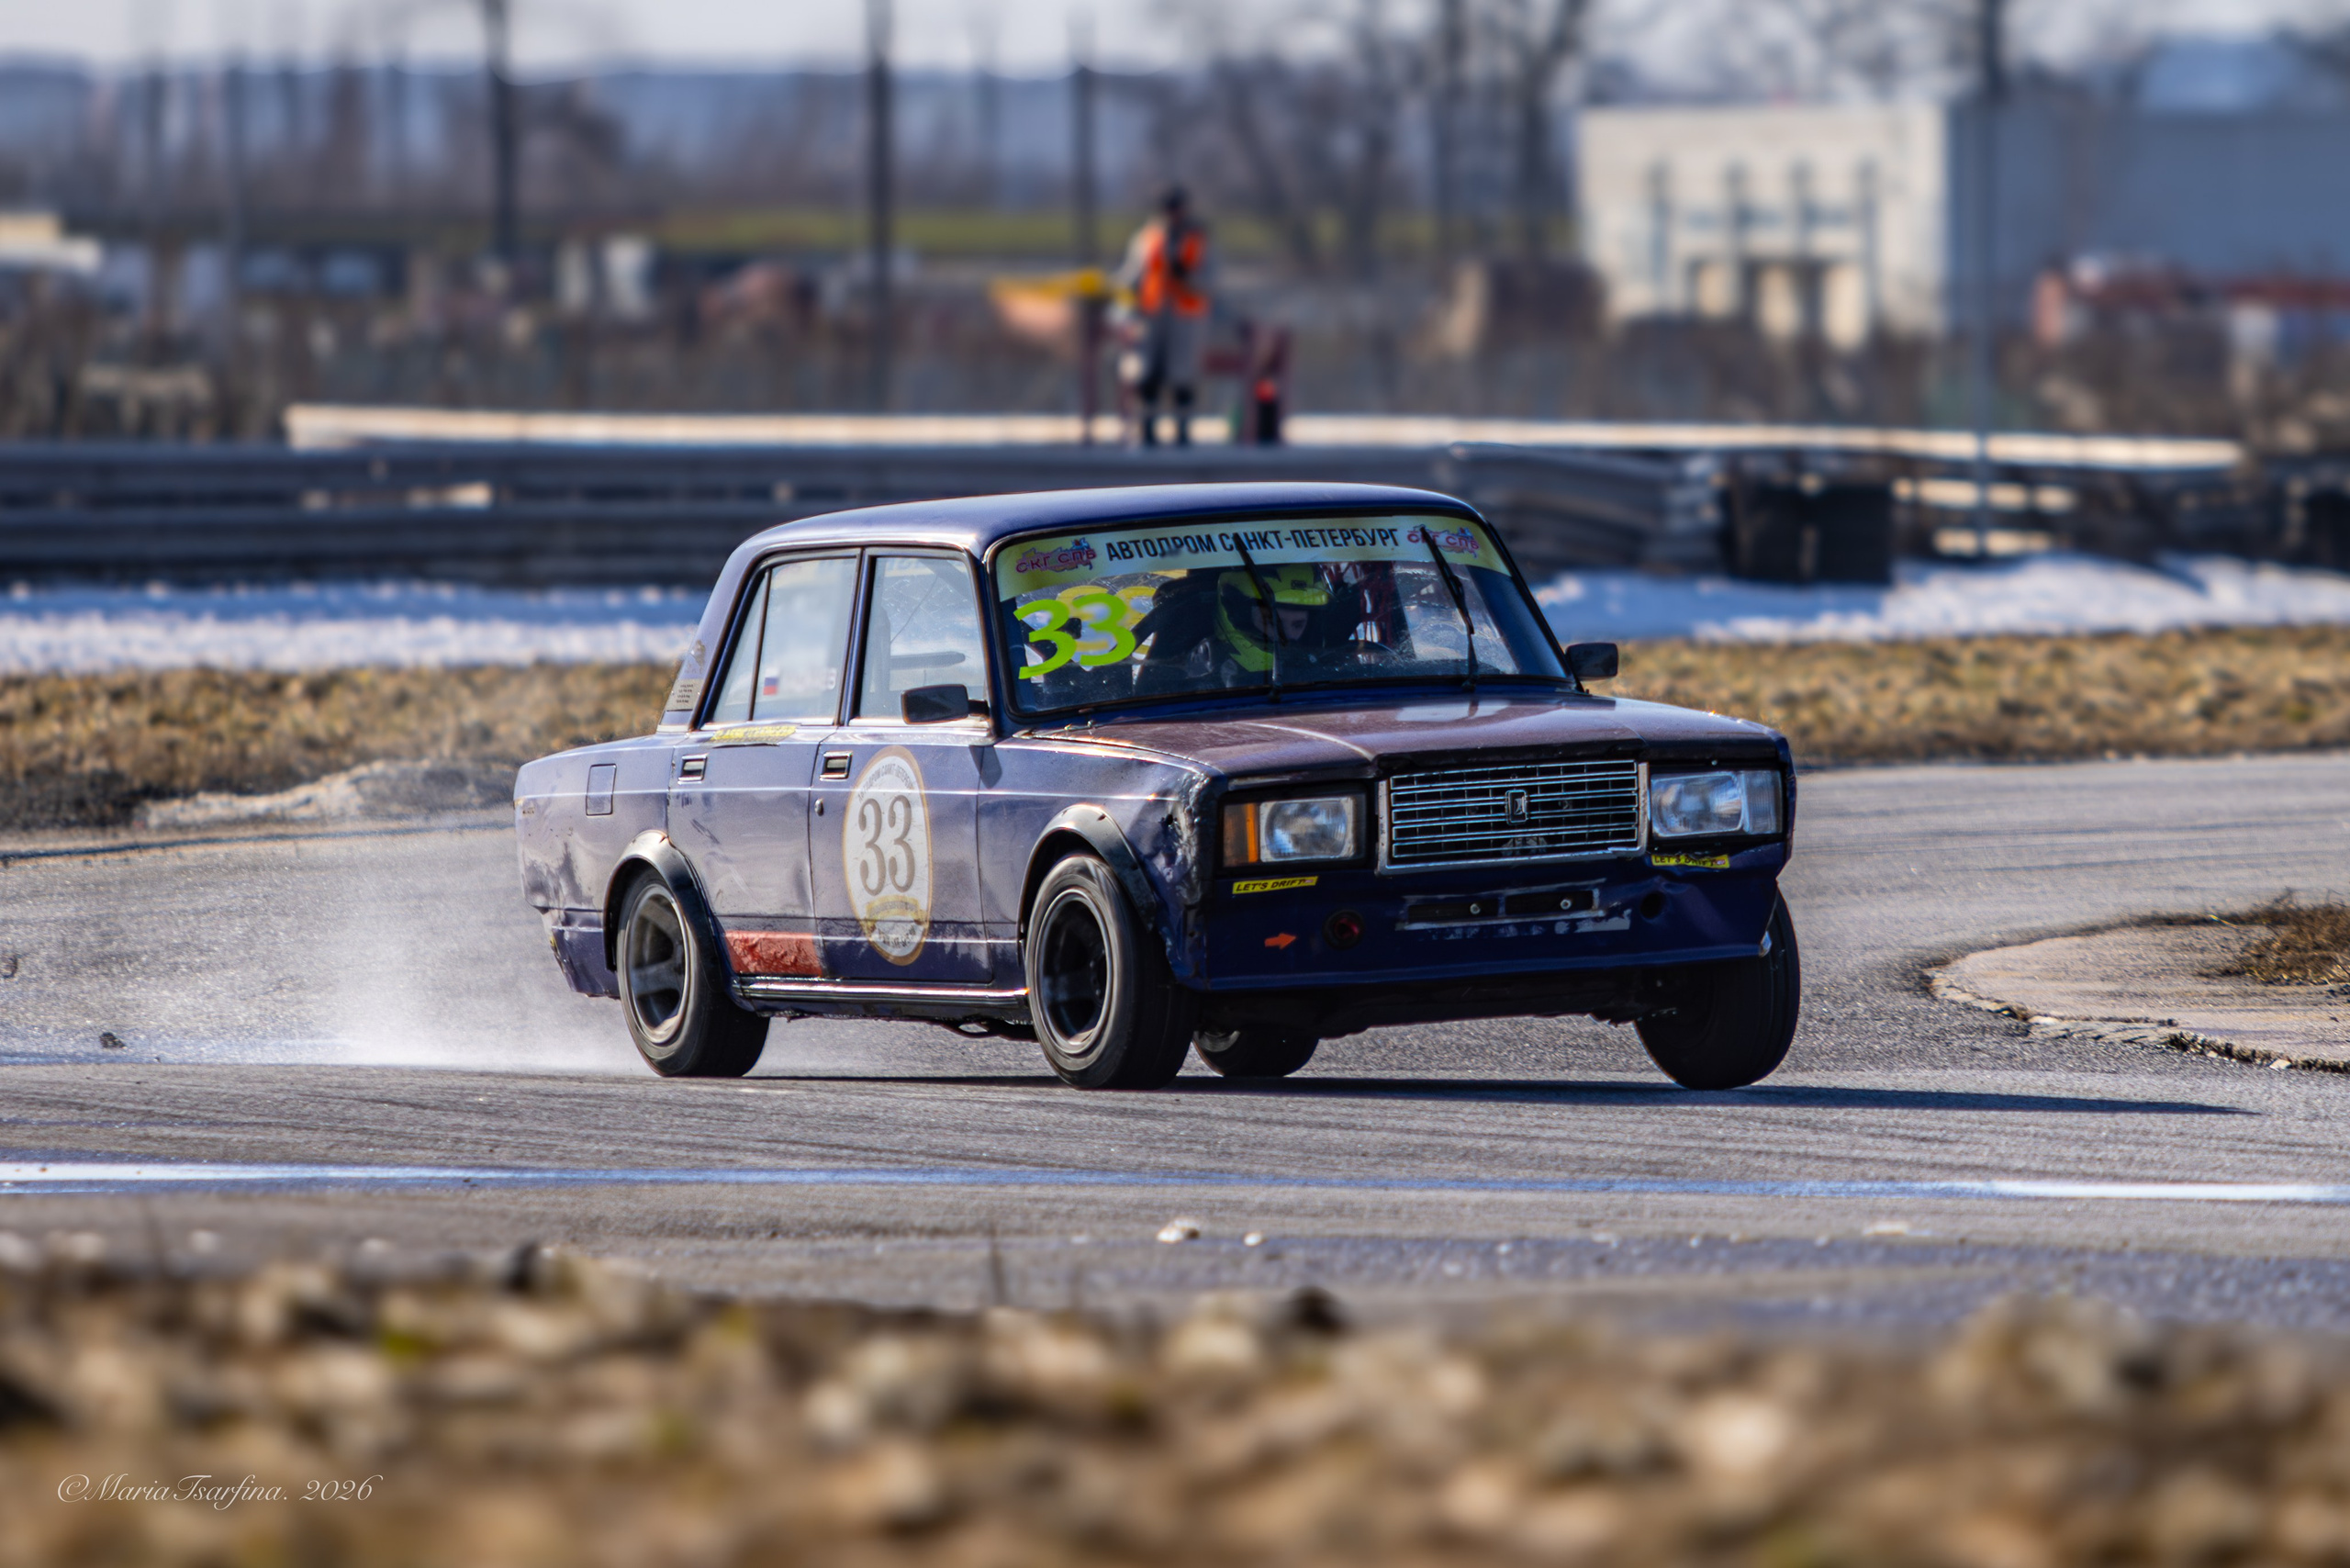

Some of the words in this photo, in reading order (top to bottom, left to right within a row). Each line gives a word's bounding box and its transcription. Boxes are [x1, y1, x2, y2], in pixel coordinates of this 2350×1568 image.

[1013, 592, 1136, 679] 33
[858, 794, 915, 896] 33
[1236, 882, 1268, 891] LET'S
[1270, 879, 1305, 889] DRIFT
